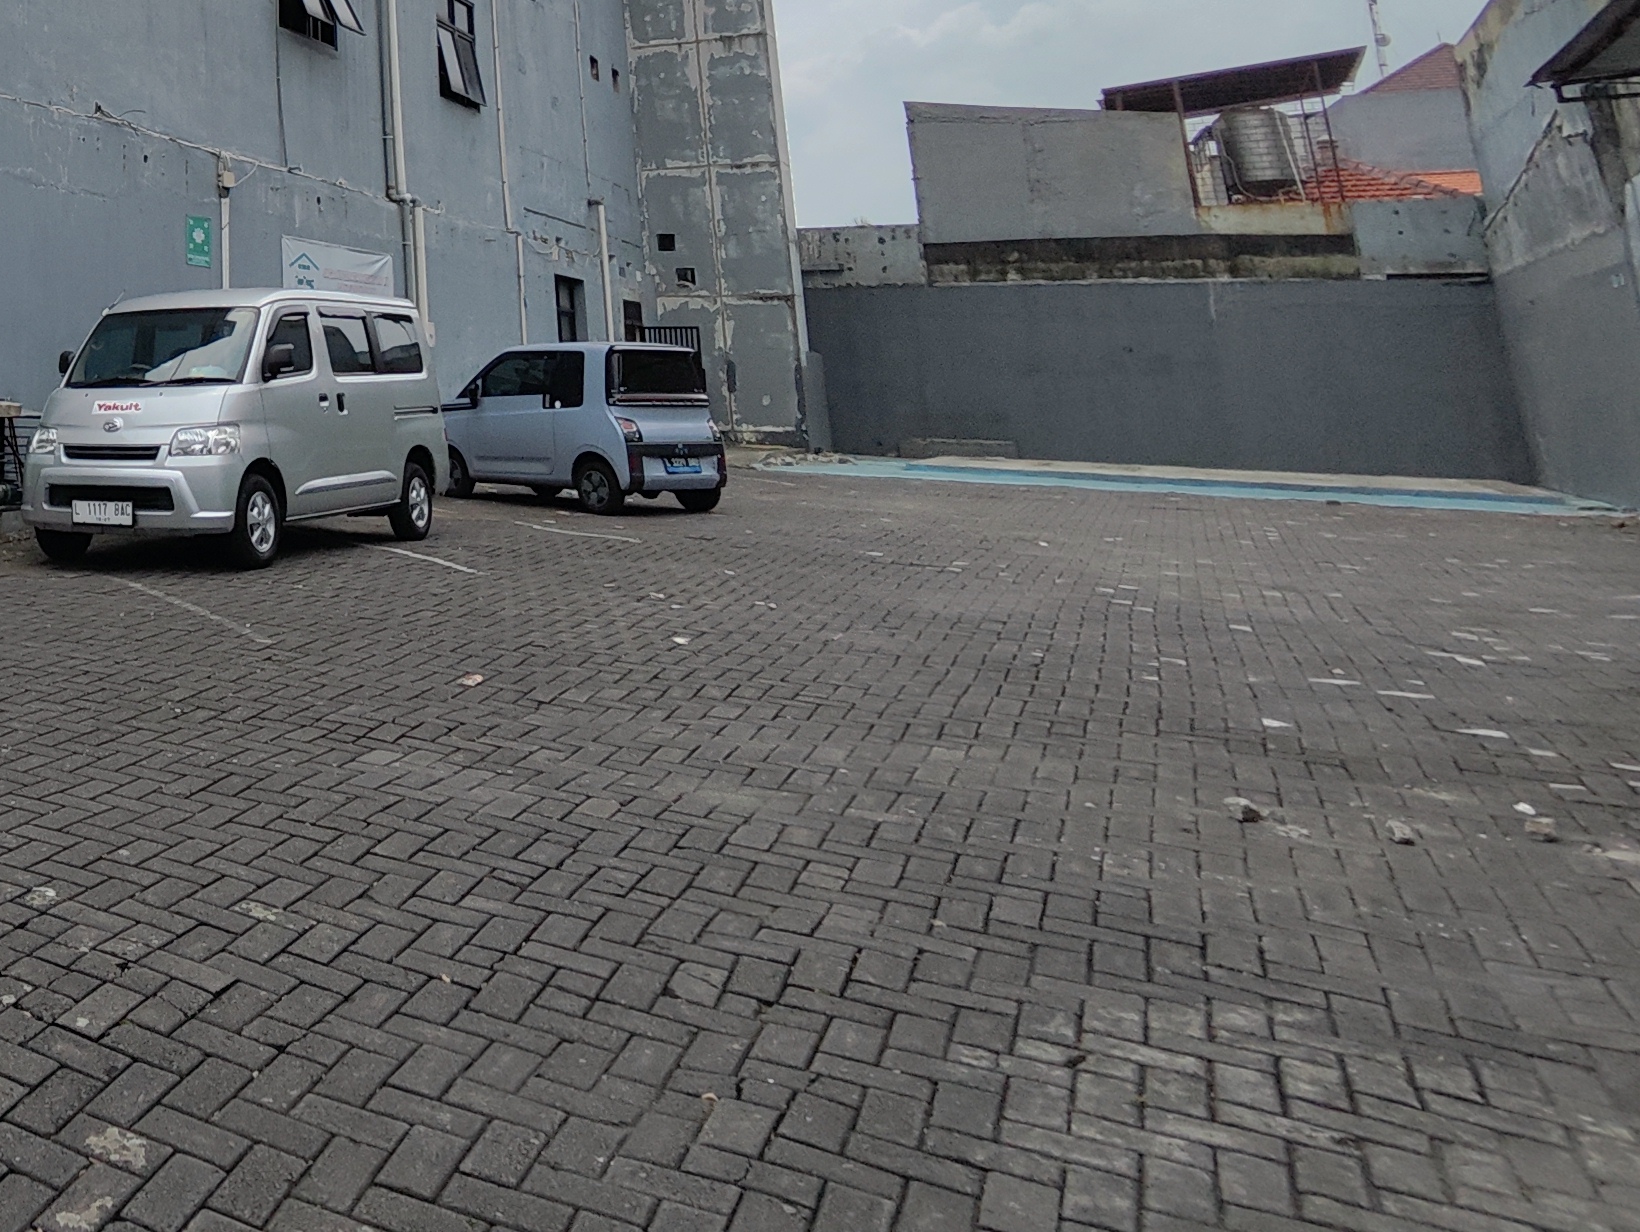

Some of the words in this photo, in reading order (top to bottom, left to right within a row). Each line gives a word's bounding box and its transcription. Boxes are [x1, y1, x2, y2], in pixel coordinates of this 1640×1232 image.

[97, 402, 142, 412] Yakult
[74, 503, 81, 516] L
[87, 502, 108, 517] 1117
